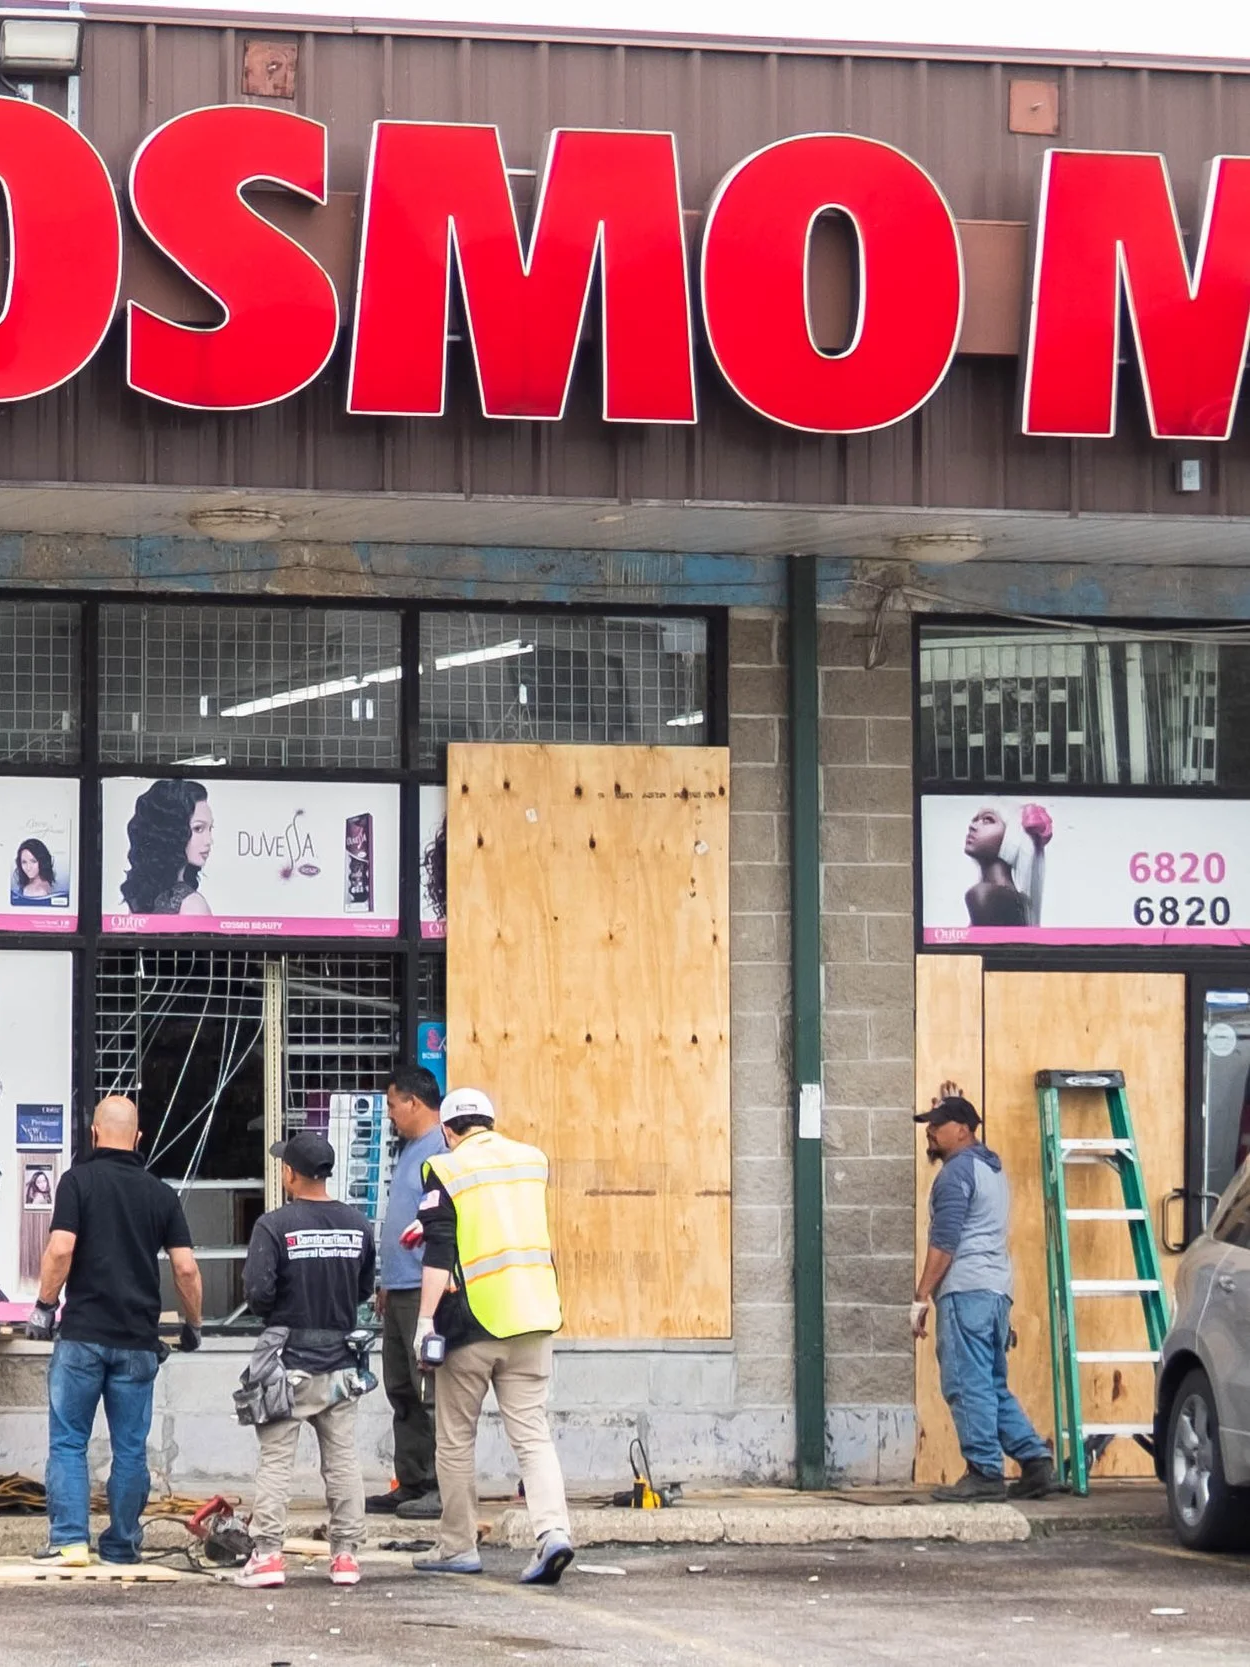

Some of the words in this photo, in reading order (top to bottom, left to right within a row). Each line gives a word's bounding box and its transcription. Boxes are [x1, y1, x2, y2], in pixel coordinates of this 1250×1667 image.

[237, 813, 315, 872] DUVESSA
[1128, 851, 1227, 884] 6820
[220, 921, 250, 930] COSMO
[251, 921, 283, 931] BEAUTY
[1133, 896, 1231, 926] 6820
